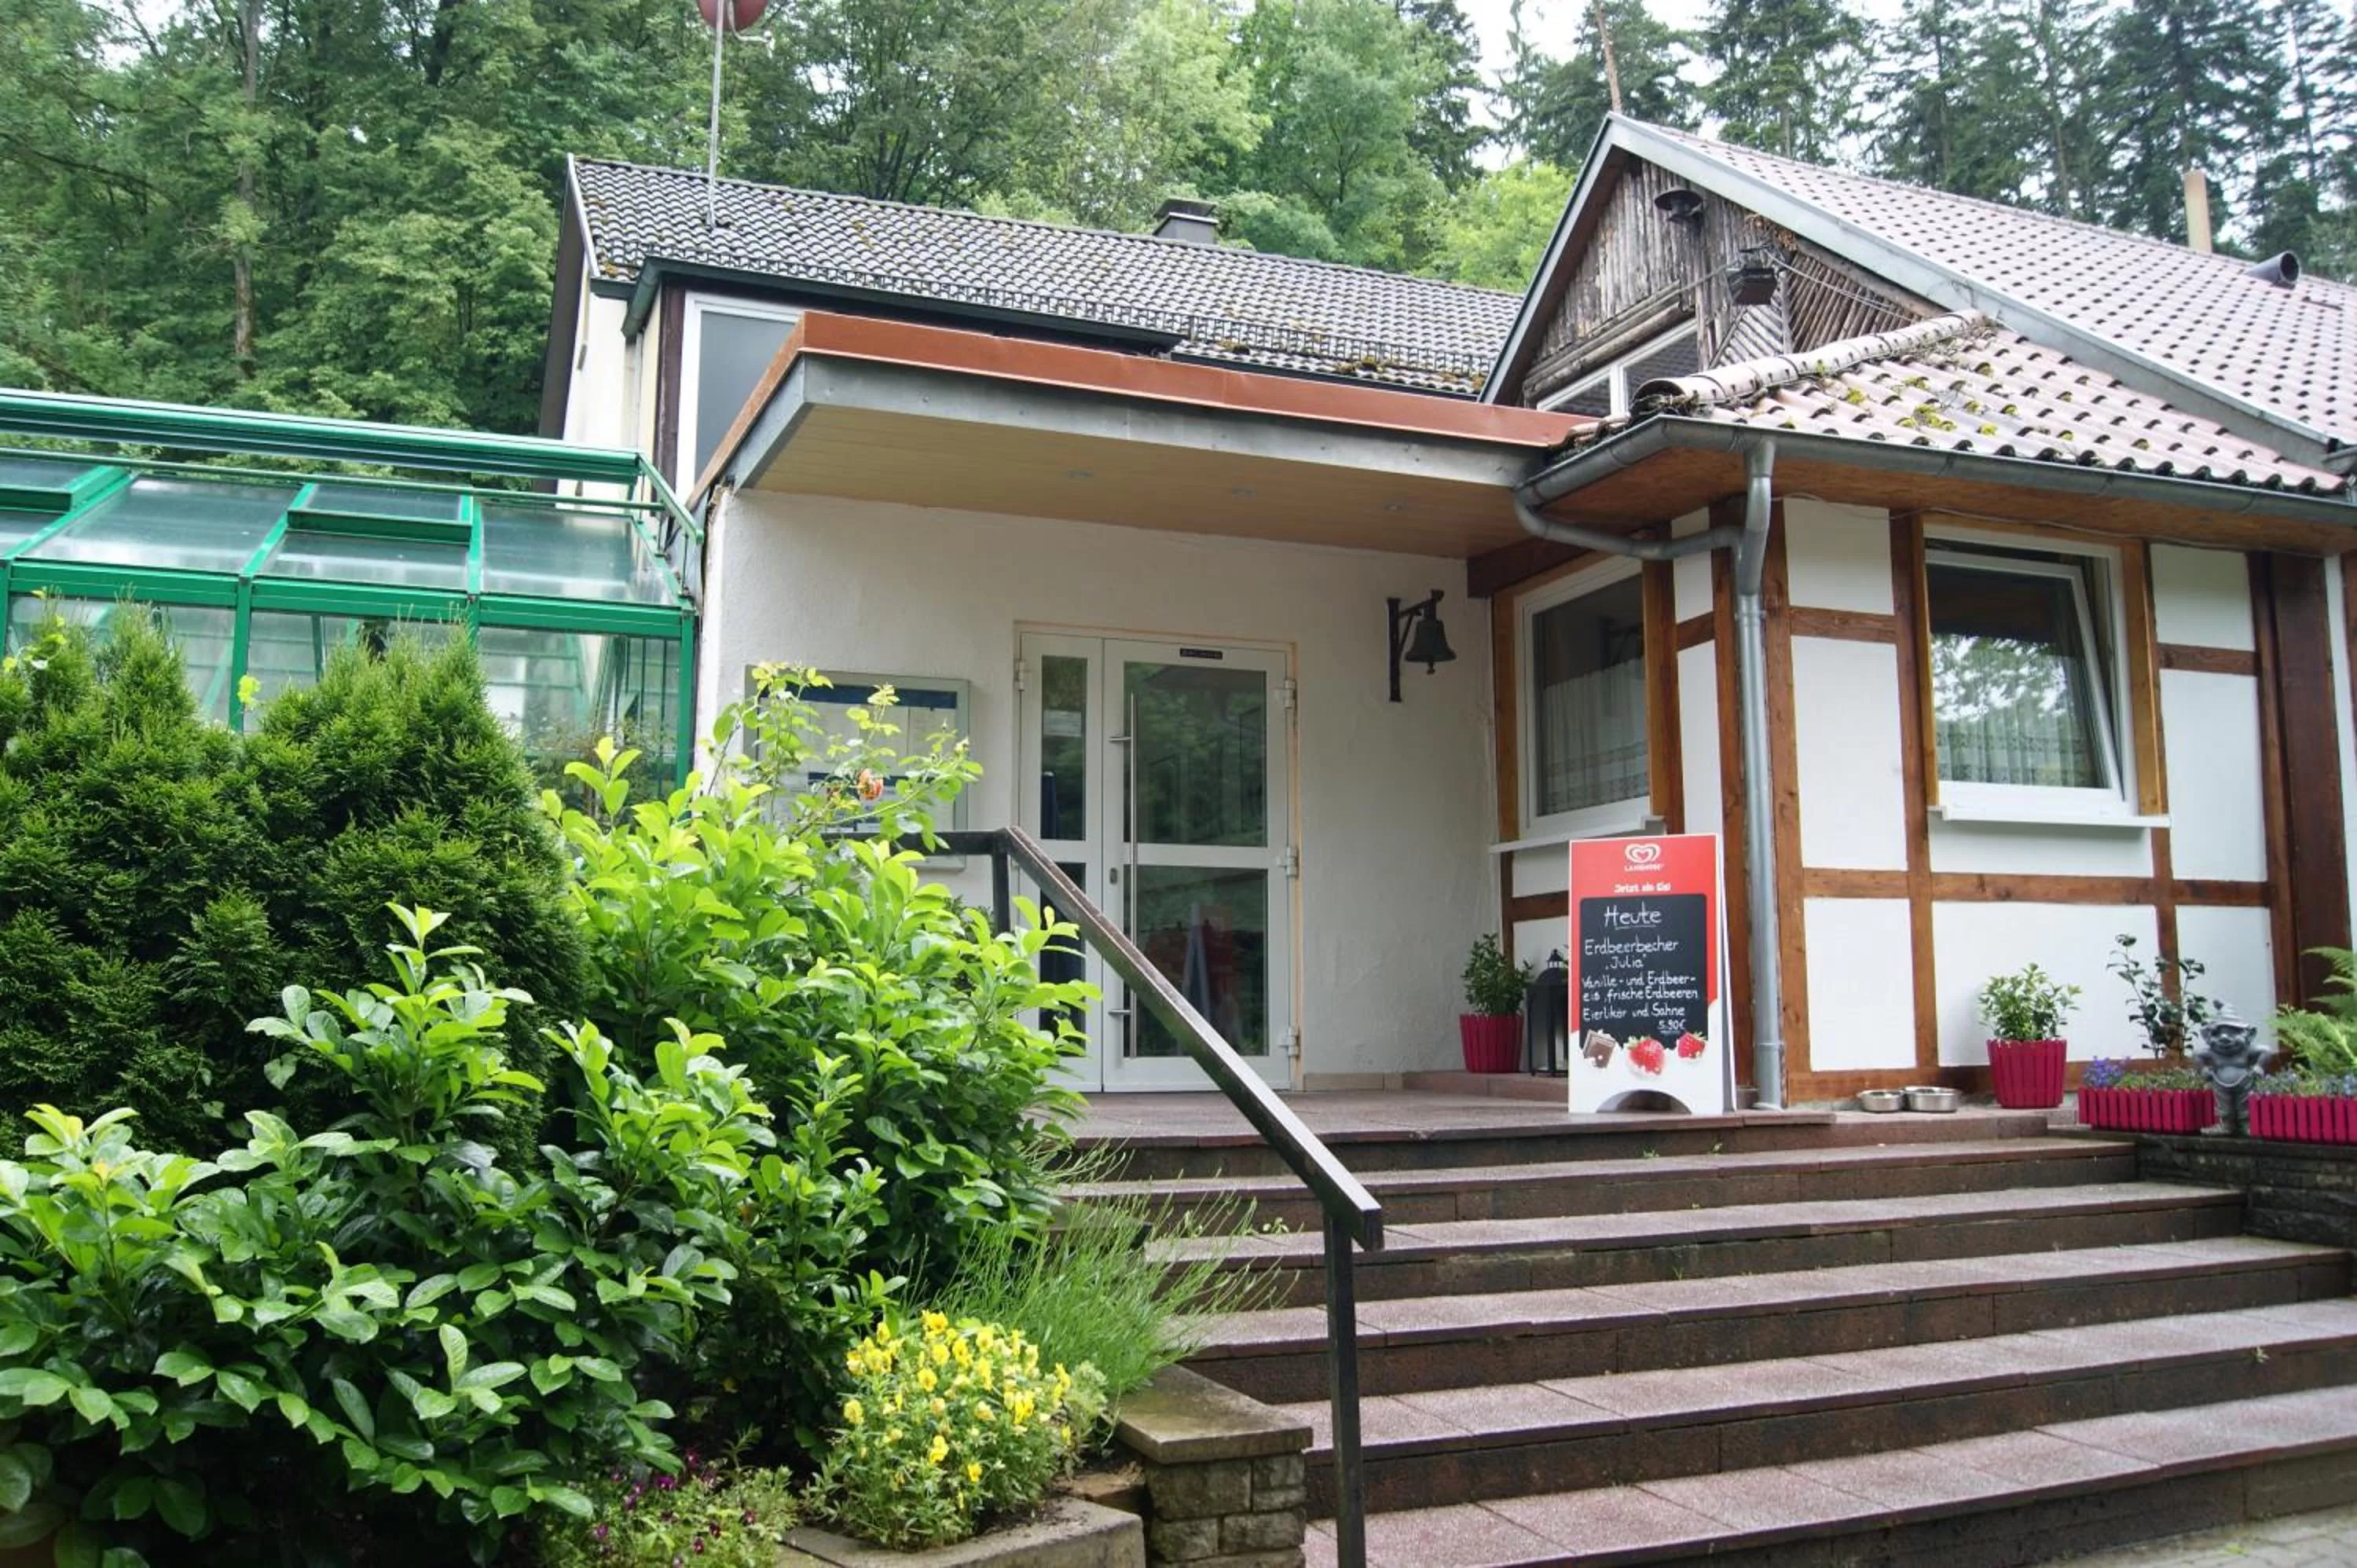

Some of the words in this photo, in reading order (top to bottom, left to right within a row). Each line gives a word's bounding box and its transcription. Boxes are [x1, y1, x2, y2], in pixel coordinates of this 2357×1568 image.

[1604, 901, 1662, 927] Heute
[1585, 934, 1679, 955] Erdbeerbecher
[1626, 972, 1644, 986] und
[1648, 970, 1696, 986] Erdbeer-
[1607, 987, 1644, 1003] frische
[1644, 984, 1698, 999] Erdbeeren
[1632, 1002, 1650, 1017] und
[1651, 1002, 1685, 1017] Sahne
